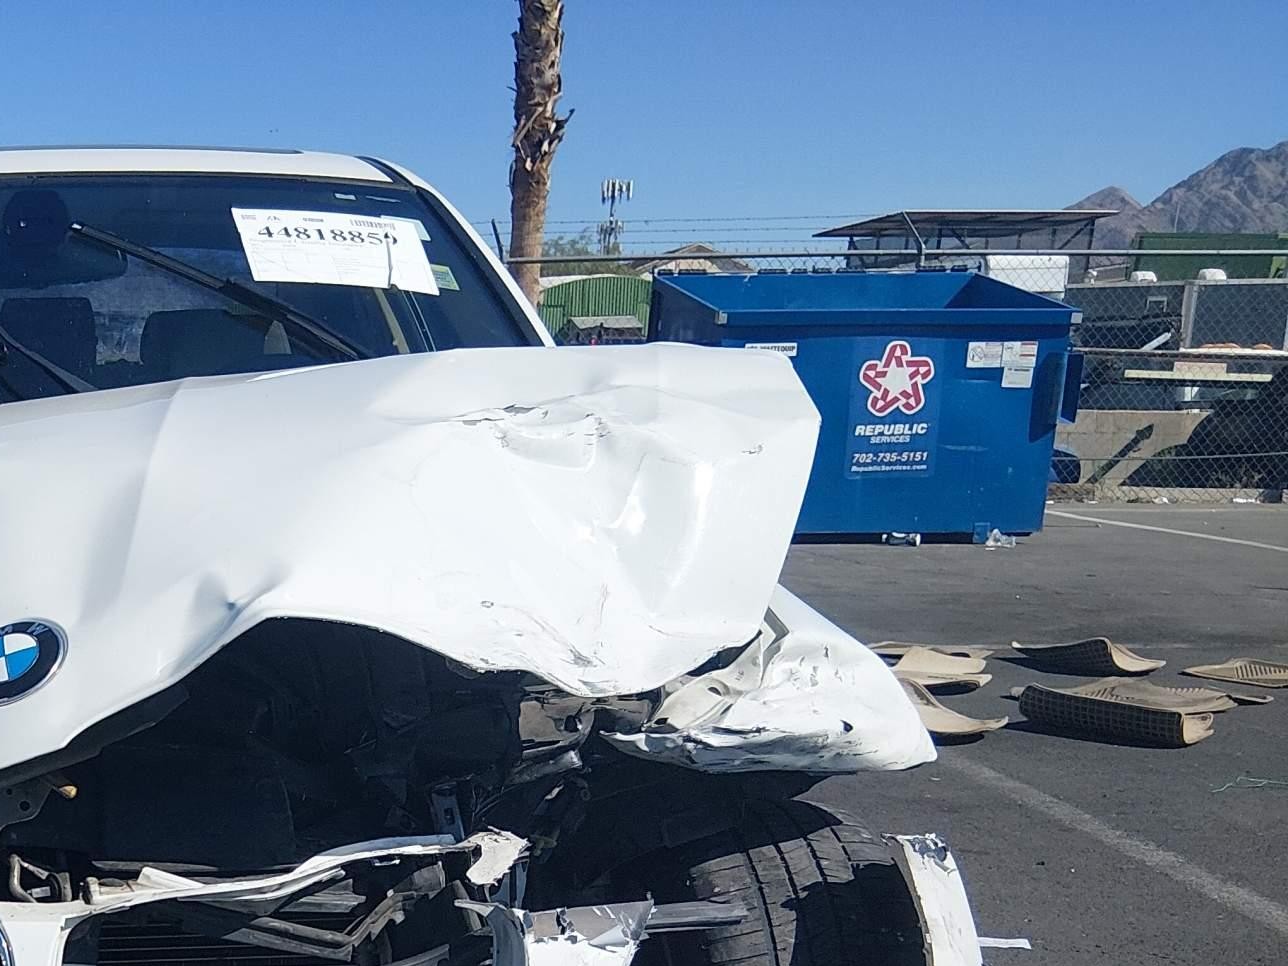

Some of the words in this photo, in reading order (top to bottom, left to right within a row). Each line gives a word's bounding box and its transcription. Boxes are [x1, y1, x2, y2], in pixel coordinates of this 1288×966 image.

[258, 225, 398, 246] 44818859
[854, 423, 928, 436] REPUBLIC
[869, 435, 911, 444] SERVICES
[852, 451, 928, 463] 702-735-5151
